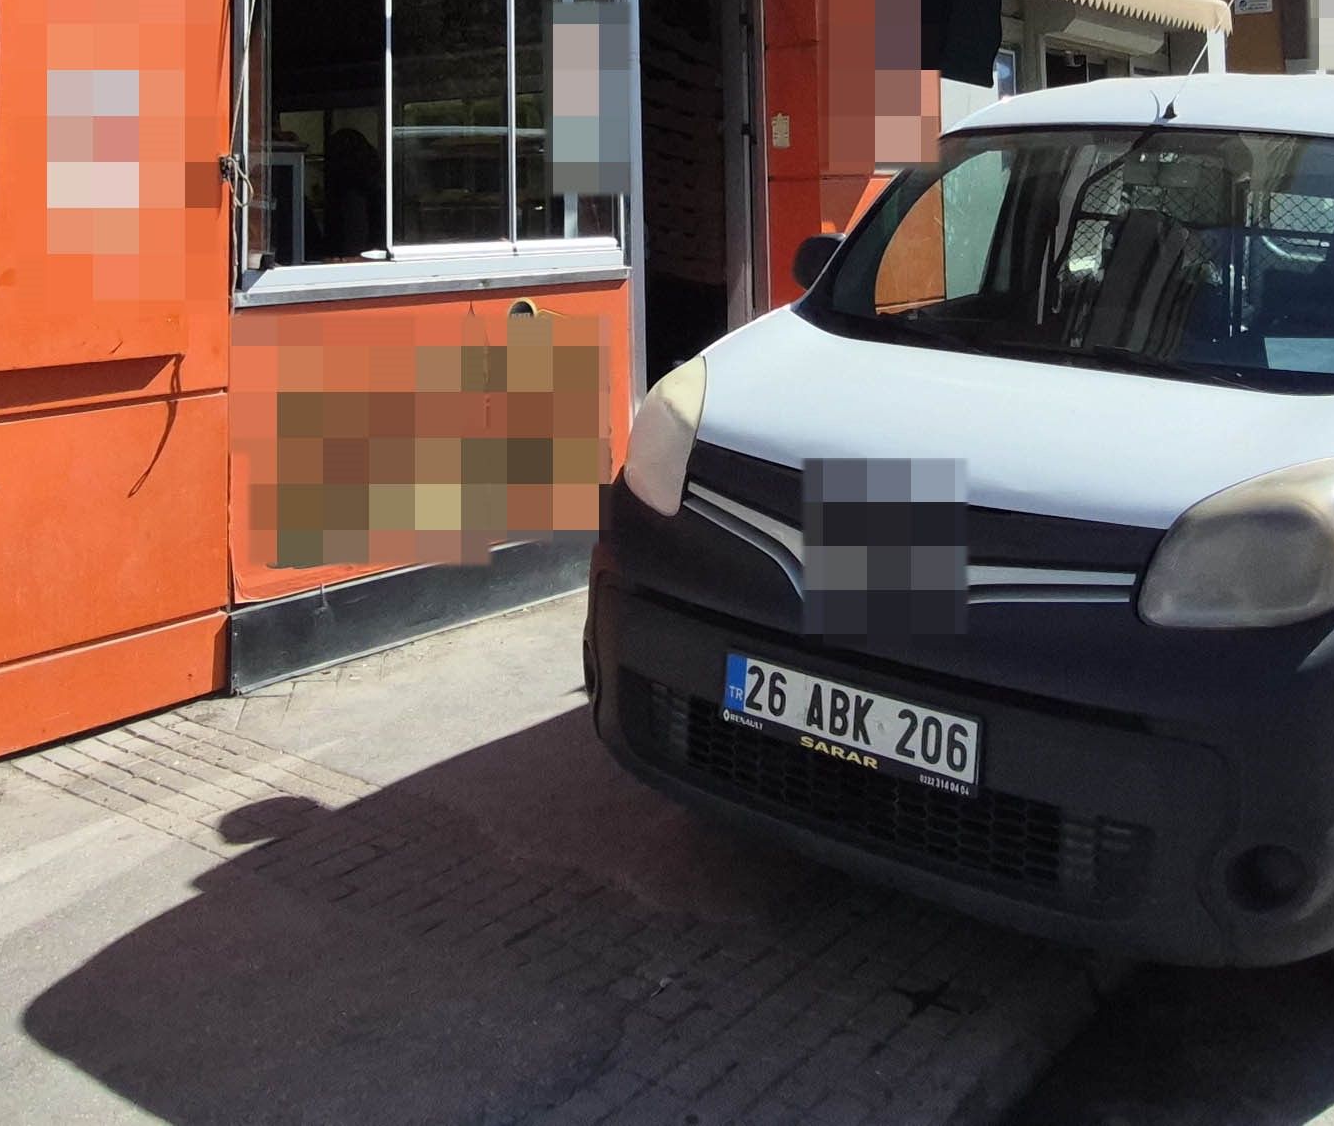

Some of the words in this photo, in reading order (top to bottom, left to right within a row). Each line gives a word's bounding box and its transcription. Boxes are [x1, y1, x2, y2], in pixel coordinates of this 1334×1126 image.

[728, 685, 743, 702] TR
[744, 665, 787, 717] 26
[806, 683, 875, 746] ABK
[895, 708, 969, 773] 206
[799, 735, 879, 770] SARAR
